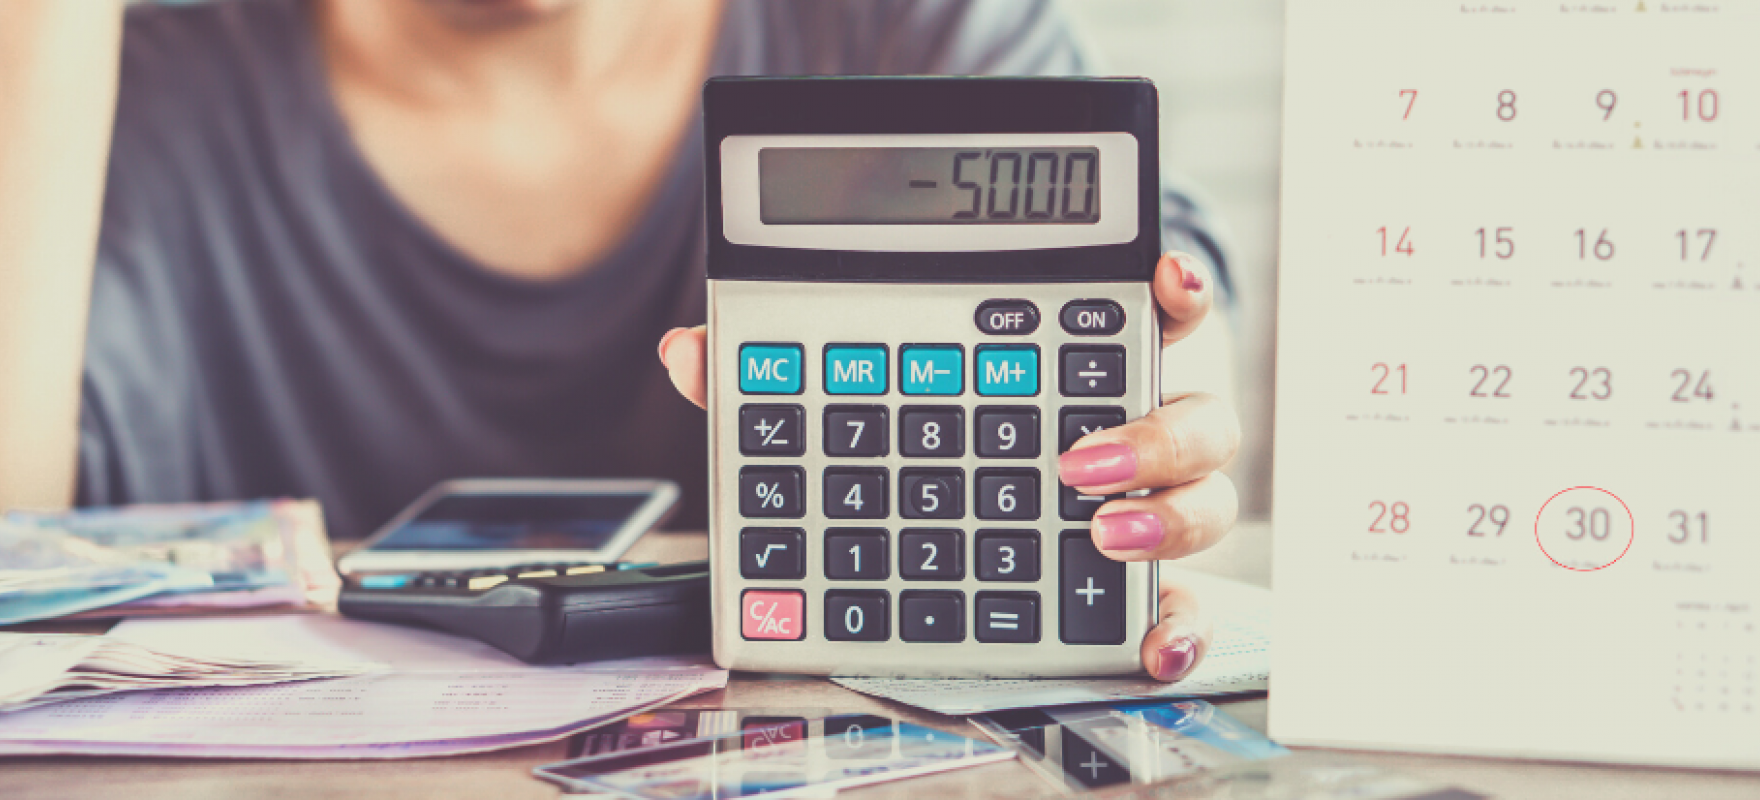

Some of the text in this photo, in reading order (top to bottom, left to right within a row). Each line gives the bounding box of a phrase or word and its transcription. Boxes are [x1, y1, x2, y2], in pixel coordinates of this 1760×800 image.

[1399, 88, 1720, 122] 7 8 9 10
[1376, 226, 1718, 262] 14 15 16 17
[989, 310, 1106, 330] OFF ON
[747, 357, 789, 382] MC
[833, 359, 874, 384] MR
[985, 360, 1027, 385] M+
[1371, 361, 1716, 403] 21 22 23 24
[846, 421, 865, 449] 7
[921, 421, 941, 450] 8
[997, 421, 1017, 450] 9
[843, 483, 864, 511] 4
[921, 484, 939, 512] 5
[997, 484, 1017, 512] 6
[1367, 500, 1710, 545] 28 29 30 31
[848, 544, 861, 573] 1
[920, 543, 940, 571] 2
[997, 546, 1017, 574] 3
[844, 605, 864, 634] 0
